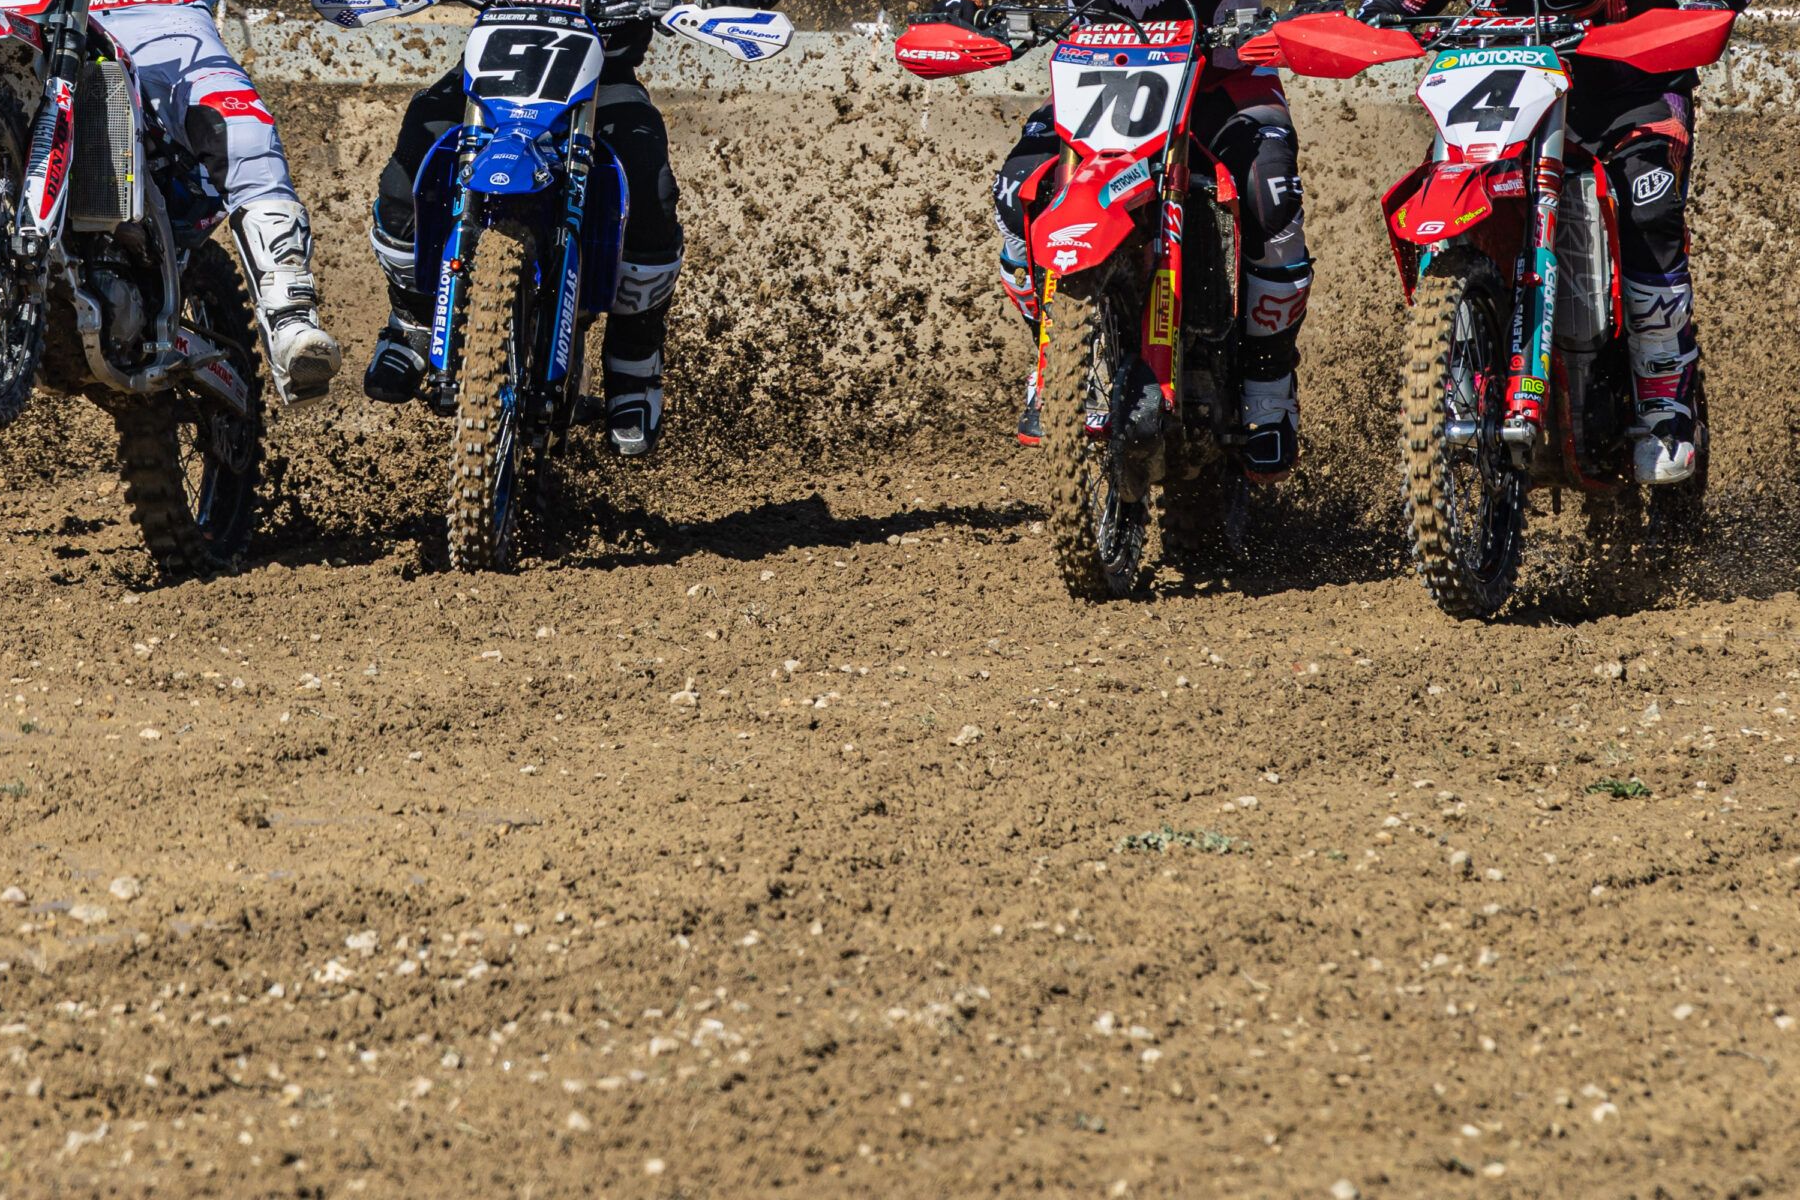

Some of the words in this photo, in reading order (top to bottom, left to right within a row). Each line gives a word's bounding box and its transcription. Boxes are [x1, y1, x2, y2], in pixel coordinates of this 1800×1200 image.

[482, 13, 526, 22] SALGUEIRO
[727, 25, 781, 40] Polisport
[471, 28, 594, 104] 91
[897, 47, 960, 61] ACERBIS
[1458, 50, 1547, 67] MOTOREX
[1072, 70, 1169, 140] 70
[1445, 69, 1527, 133] 4
[47, 110, 69, 201] DUNLOP
[1108, 169, 1142, 196] PETRONAS
[1046, 239, 1093, 250] HONDA
[1153, 275, 1172, 339] PIRELLI
[1515, 257, 1525, 303] TYES
[1540, 259, 1559, 353] MOTOREX
[431, 260, 452, 357] MOTOBELAS
[556, 268, 580, 370] MOTOBELAS
[1513, 318, 1524, 354] PLEWS
